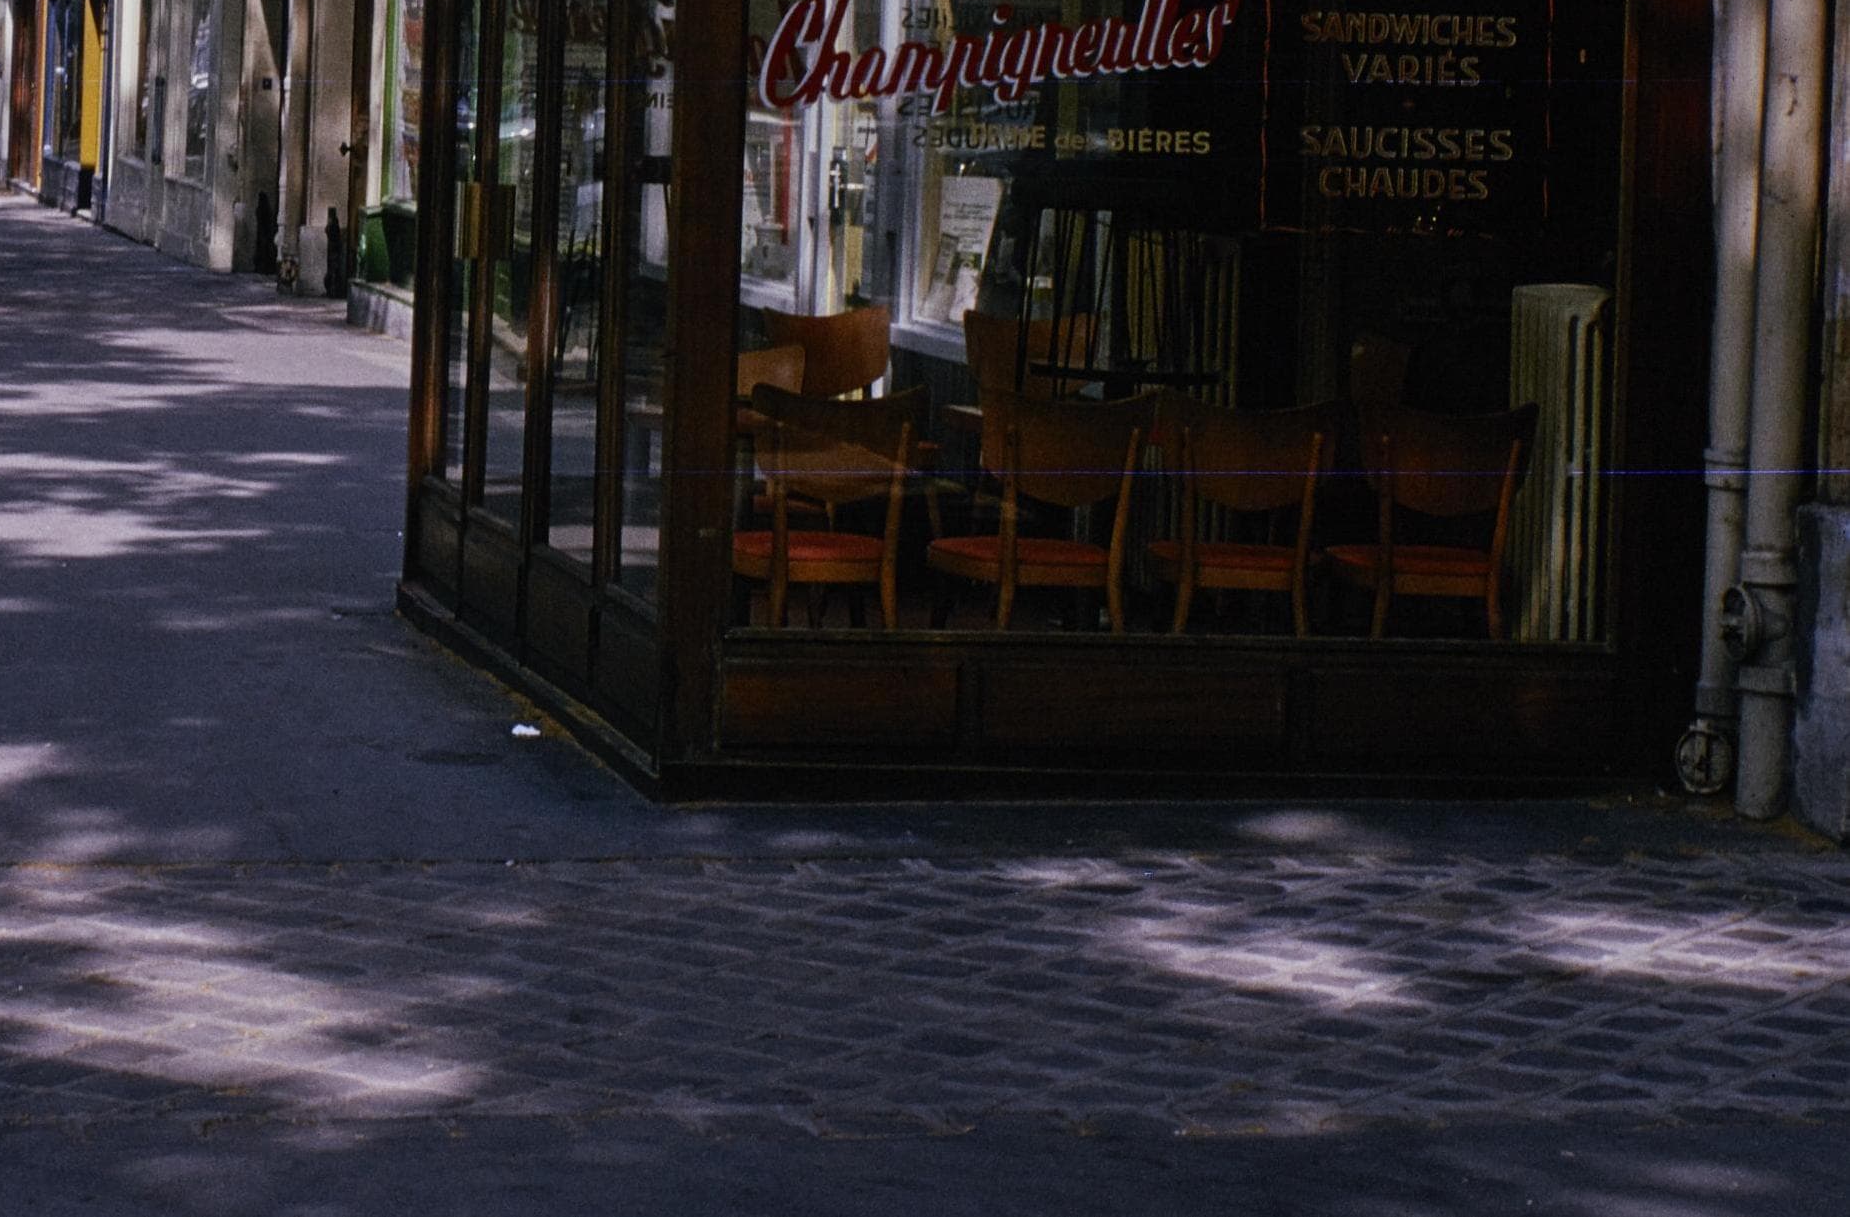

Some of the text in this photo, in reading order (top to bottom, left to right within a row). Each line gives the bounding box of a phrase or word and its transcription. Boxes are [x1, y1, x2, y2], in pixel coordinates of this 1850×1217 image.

[1300, 10, 1519, 49] SANDWICHES
[1341, 48, 1481, 86] VARIÉS
[1300, 125, 1515, 161] SAUCISSES
[1318, 165, 1490, 201] CHAUDES
